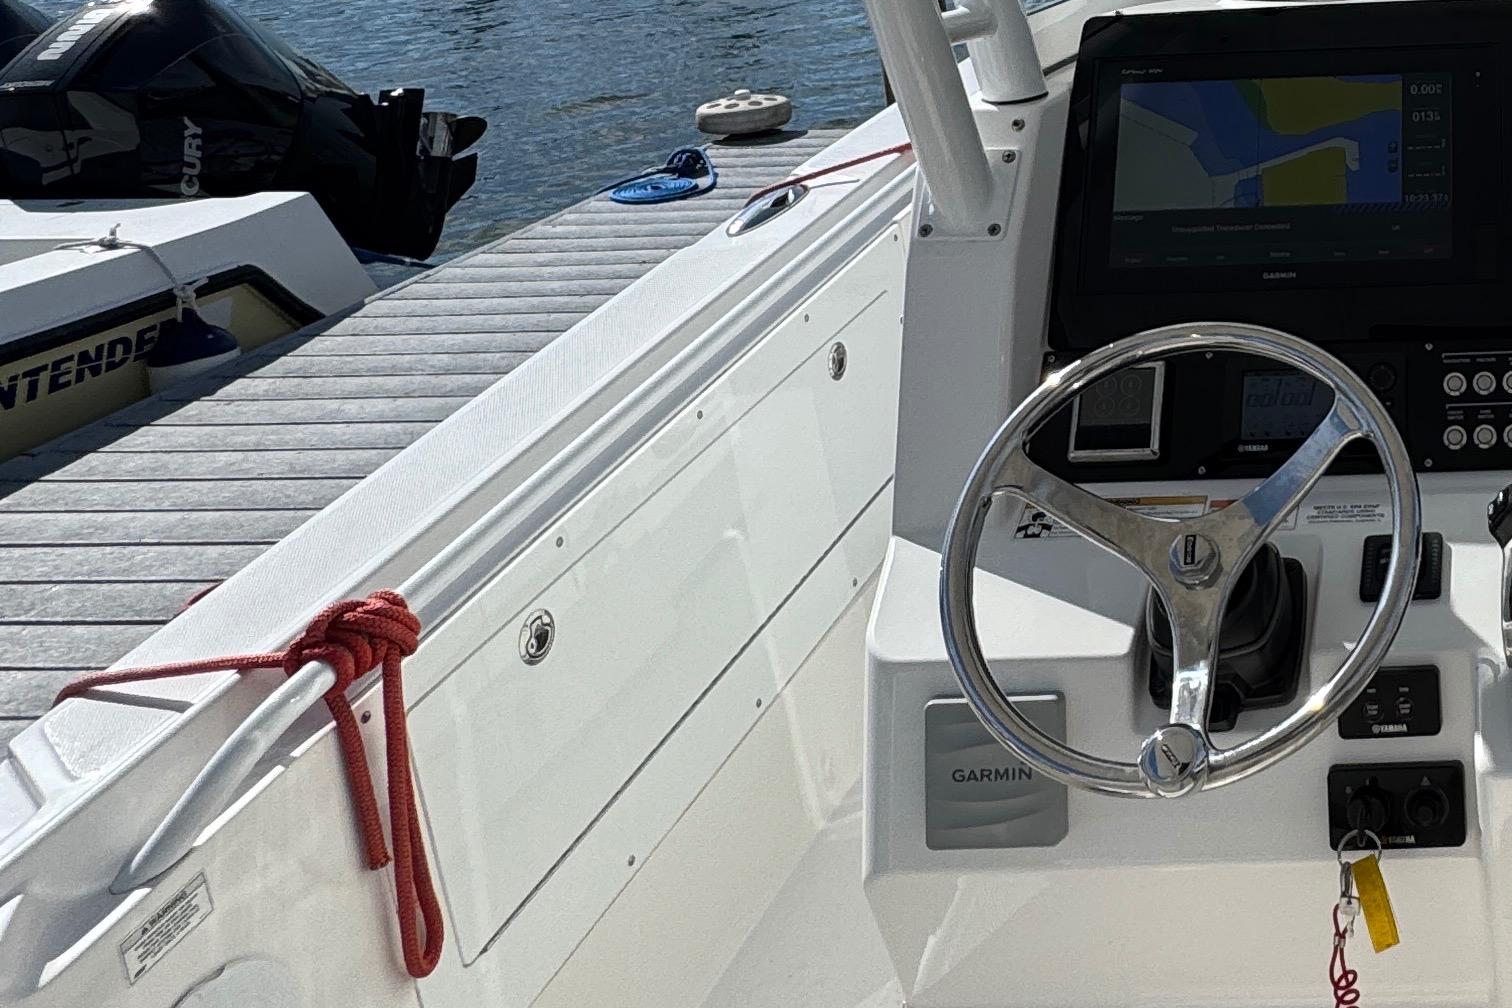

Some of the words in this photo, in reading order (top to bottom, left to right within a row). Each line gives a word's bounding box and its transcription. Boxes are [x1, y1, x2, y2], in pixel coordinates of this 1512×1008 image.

[181, 116, 203, 196] CURY
[0, 322, 162, 411] NTENDE
[951, 766, 1033, 784] GARMIN
